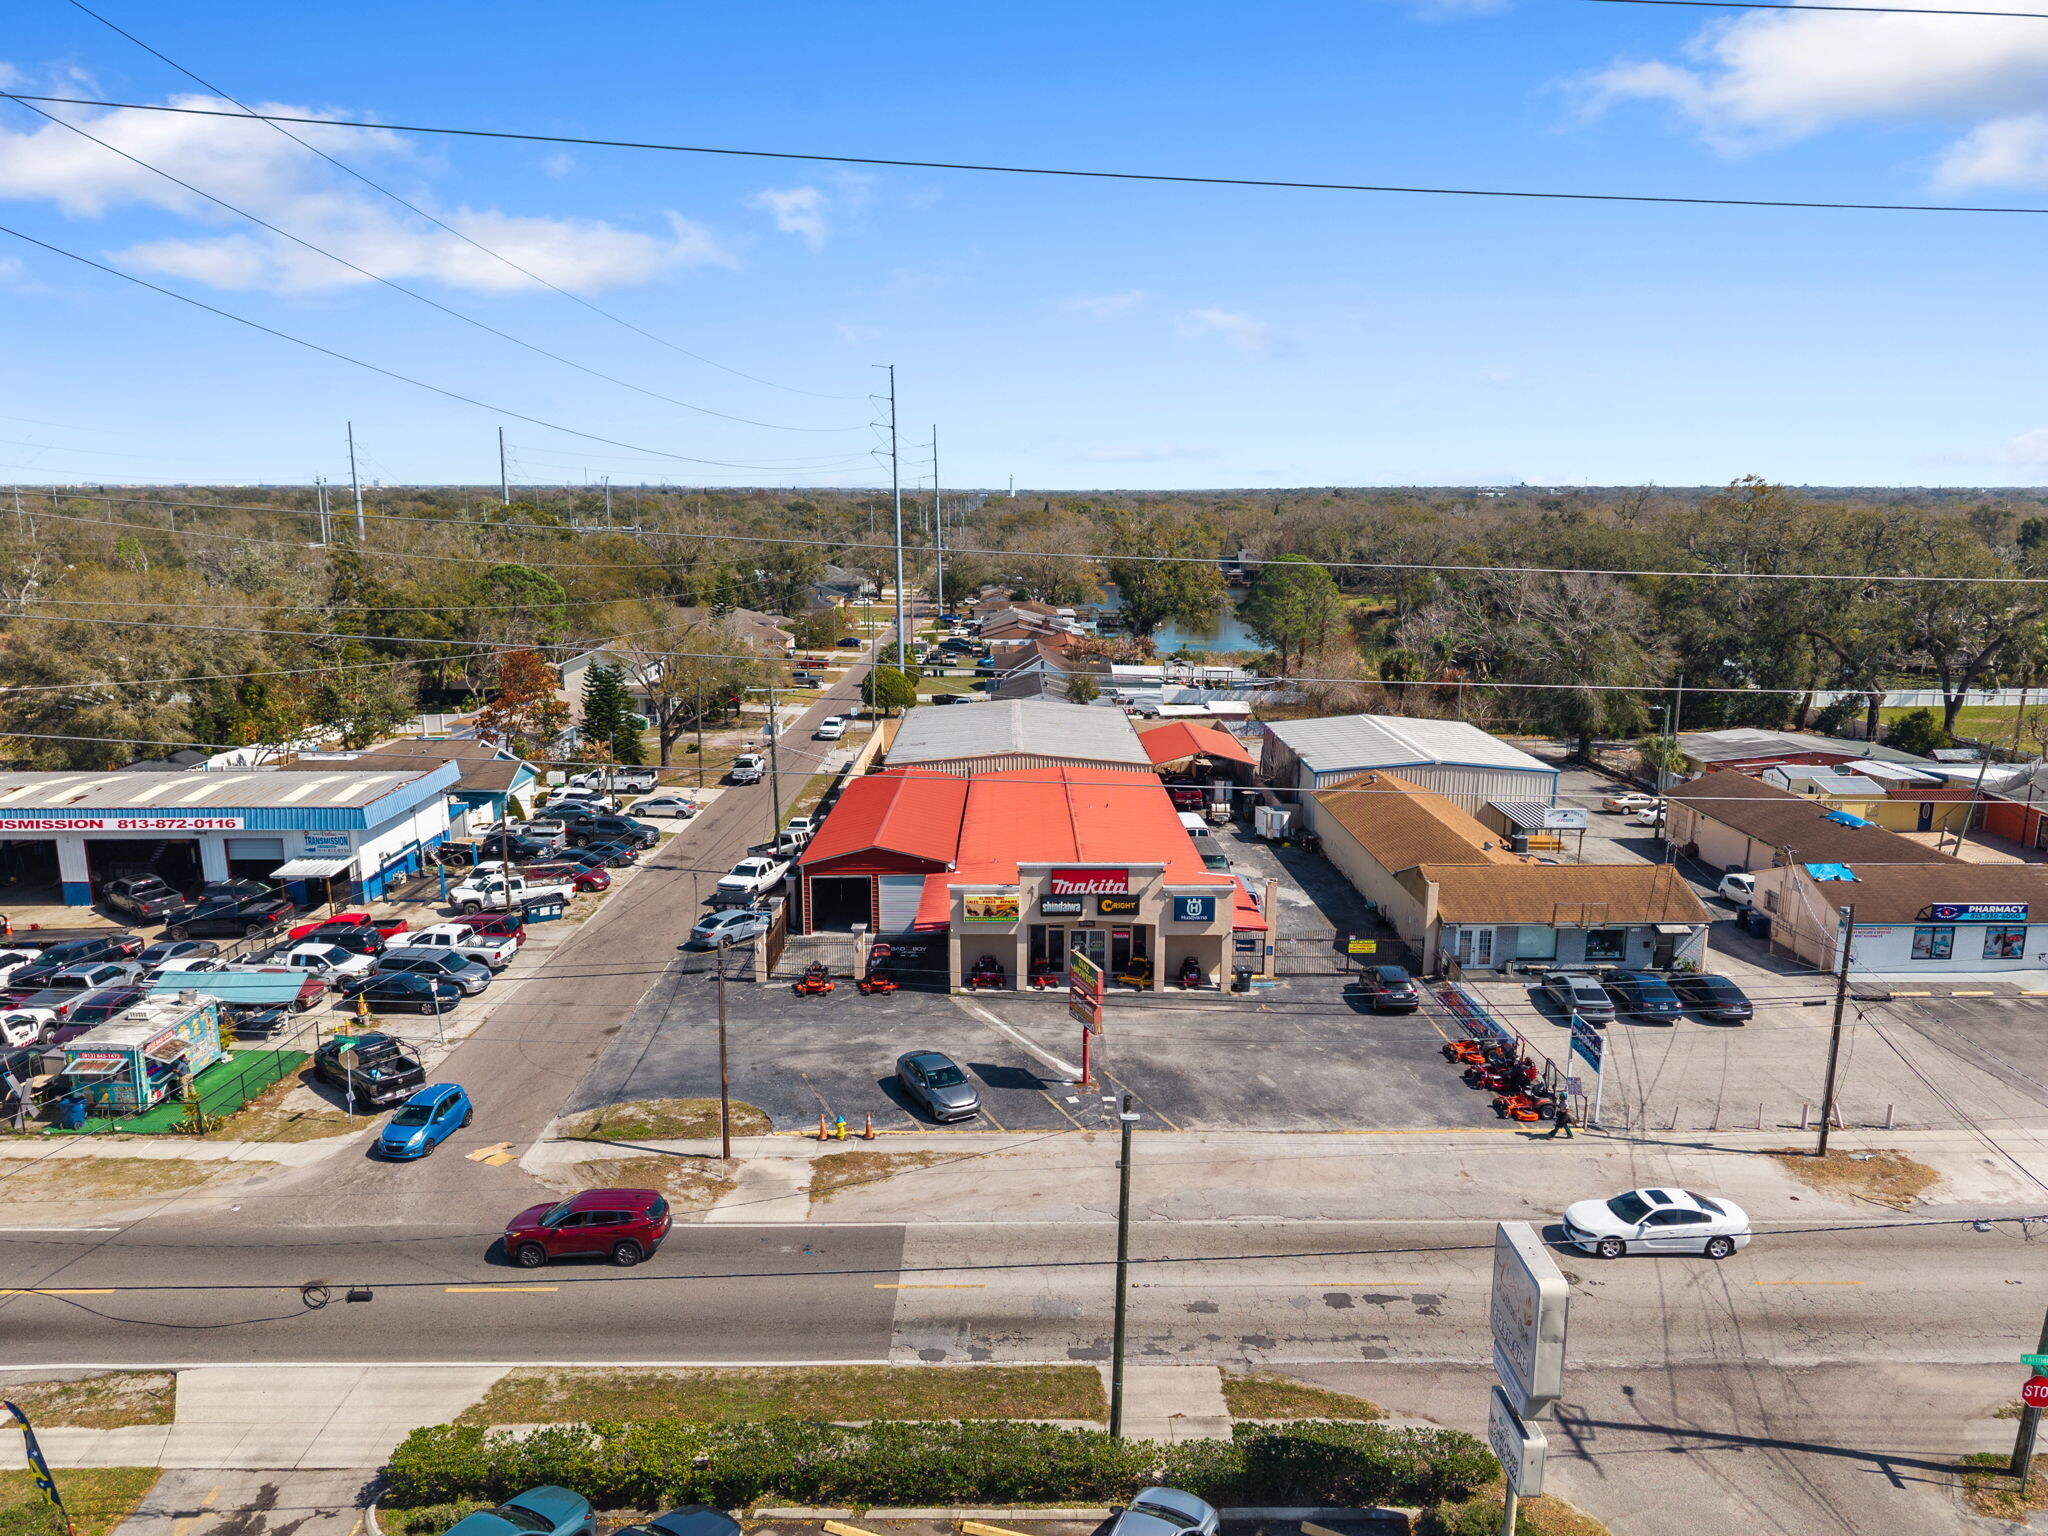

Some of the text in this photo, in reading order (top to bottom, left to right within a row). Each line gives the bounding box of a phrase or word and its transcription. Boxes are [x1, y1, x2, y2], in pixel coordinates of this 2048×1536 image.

[0, 819, 237, 829] SMISSION 813-872-0116
[304, 836, 348, 846] TRANSMISSION
[1042, 900, 1081, 912] shindaiwa
[1101, 899, 1136, 912] WRIGHT
